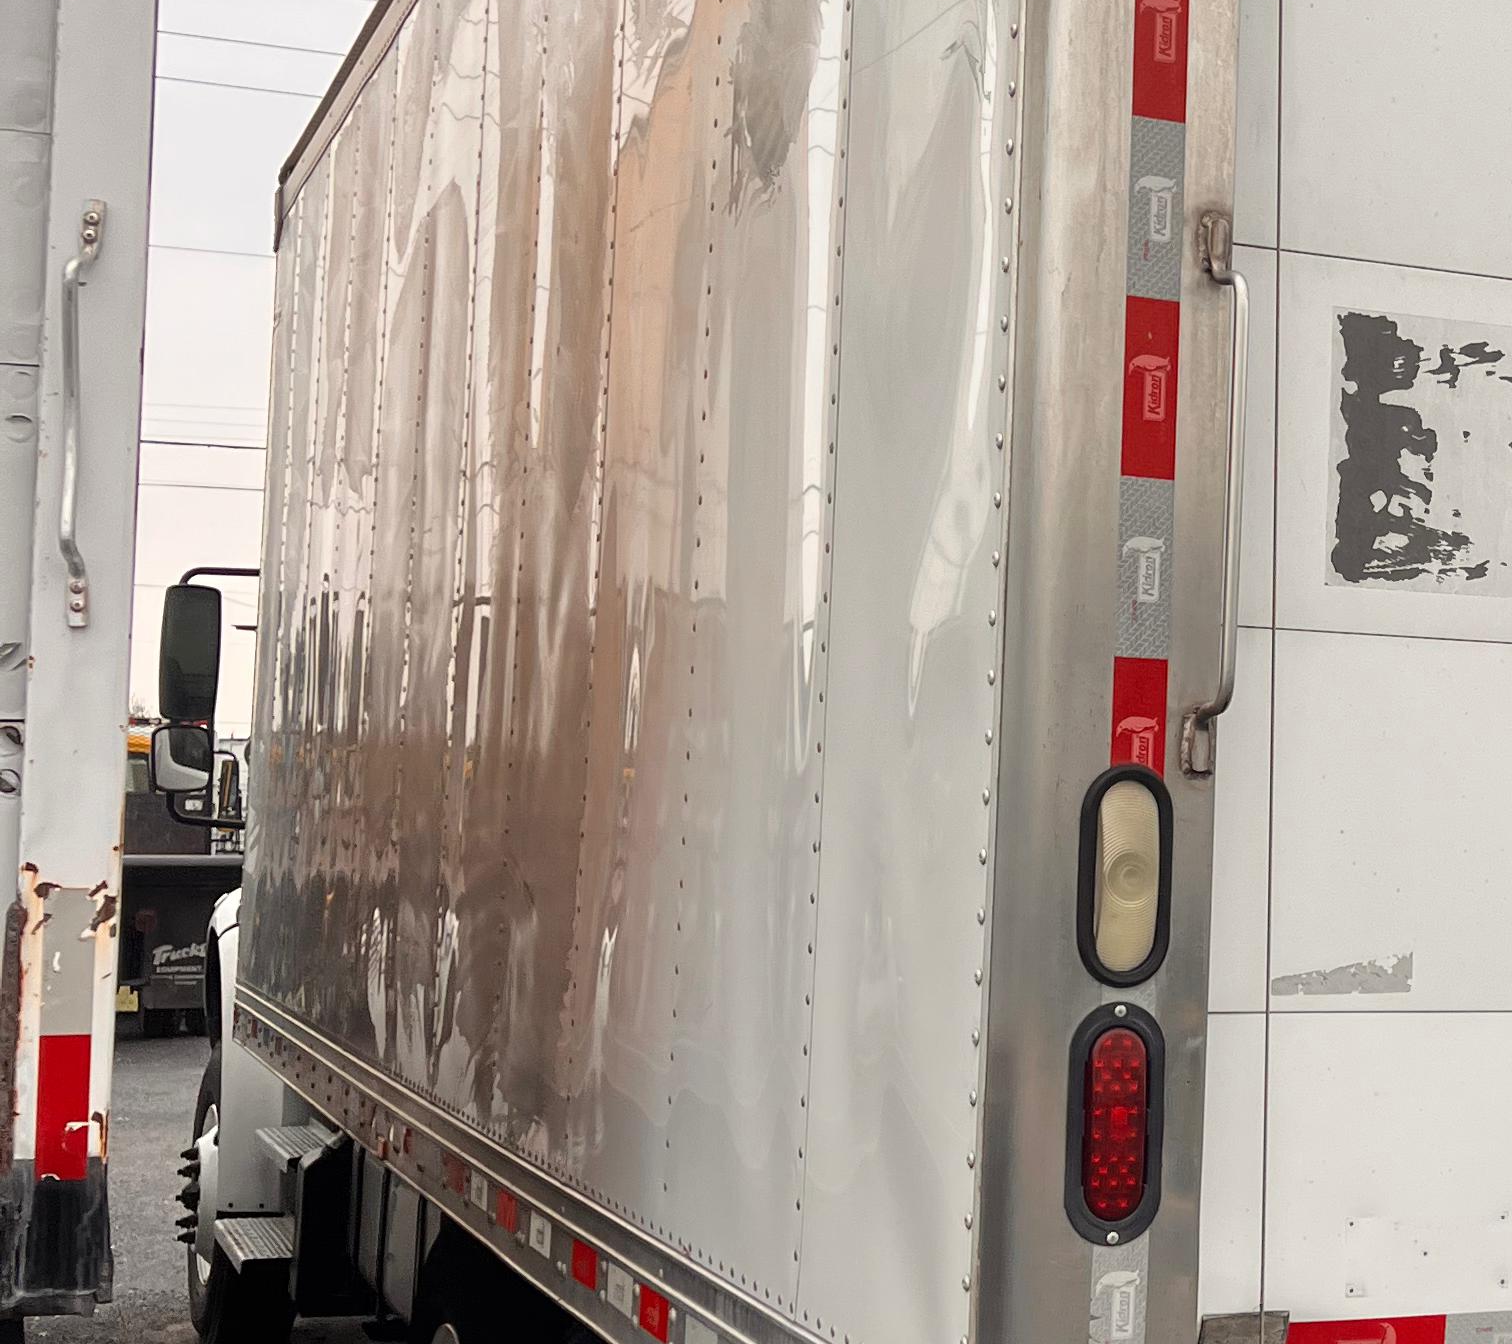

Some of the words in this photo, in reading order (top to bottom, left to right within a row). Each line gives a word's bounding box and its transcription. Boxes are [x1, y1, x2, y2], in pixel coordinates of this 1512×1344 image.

[1158, 15, 1173, 58] Kidron
[1152, 195, 1168, 237] Kidron
[1147, 374, 1162, 416] Kidron
[1141, 555, 1156, 597] Kidron
[1115, 1290, 1132, 1333] Kidron
